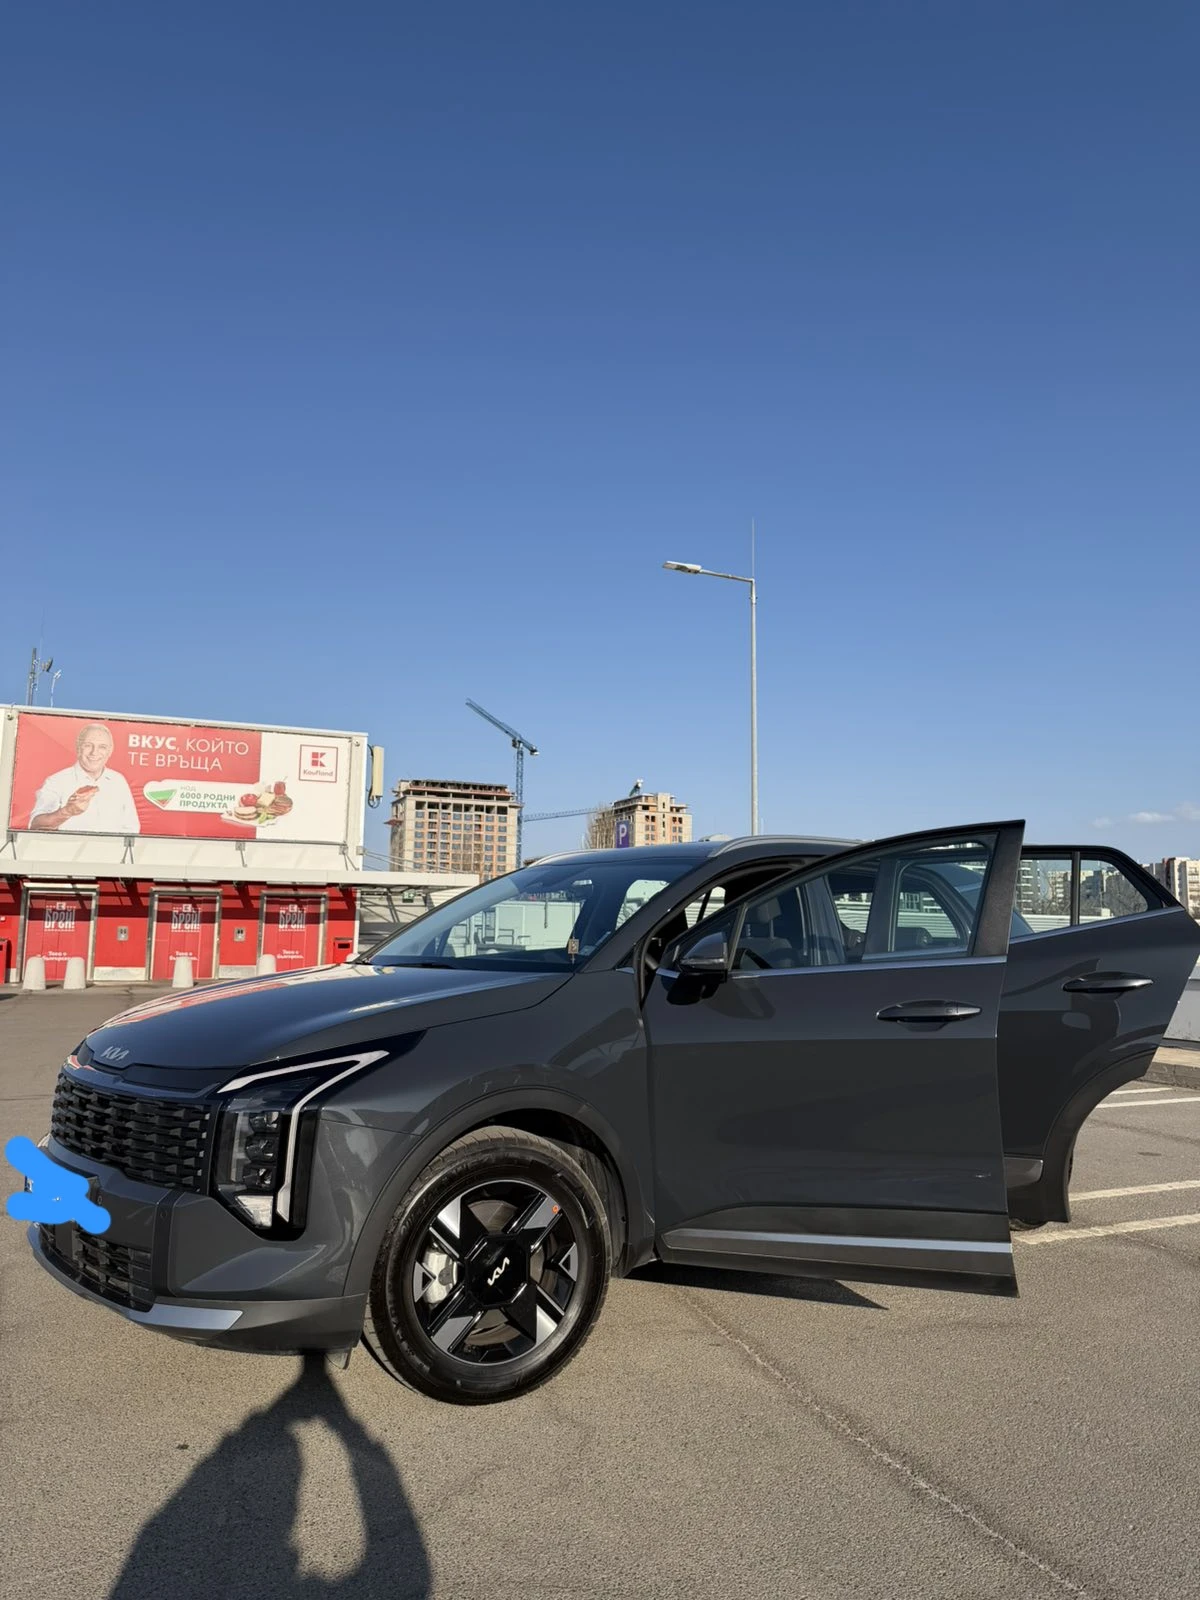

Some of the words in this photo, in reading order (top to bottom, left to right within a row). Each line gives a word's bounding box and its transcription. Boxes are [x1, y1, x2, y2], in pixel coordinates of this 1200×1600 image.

[128, 734, 180, 752] ВКУС,
[186, 738, 249, 755] КОЙТО
[128, 752, 150, 766] ТЕ
[156, 754, 223, 772] ВРЪЩА
[303, 769, 334, 777] Kaufland
[180, 801, 228, 809] ПРОДУКТА
